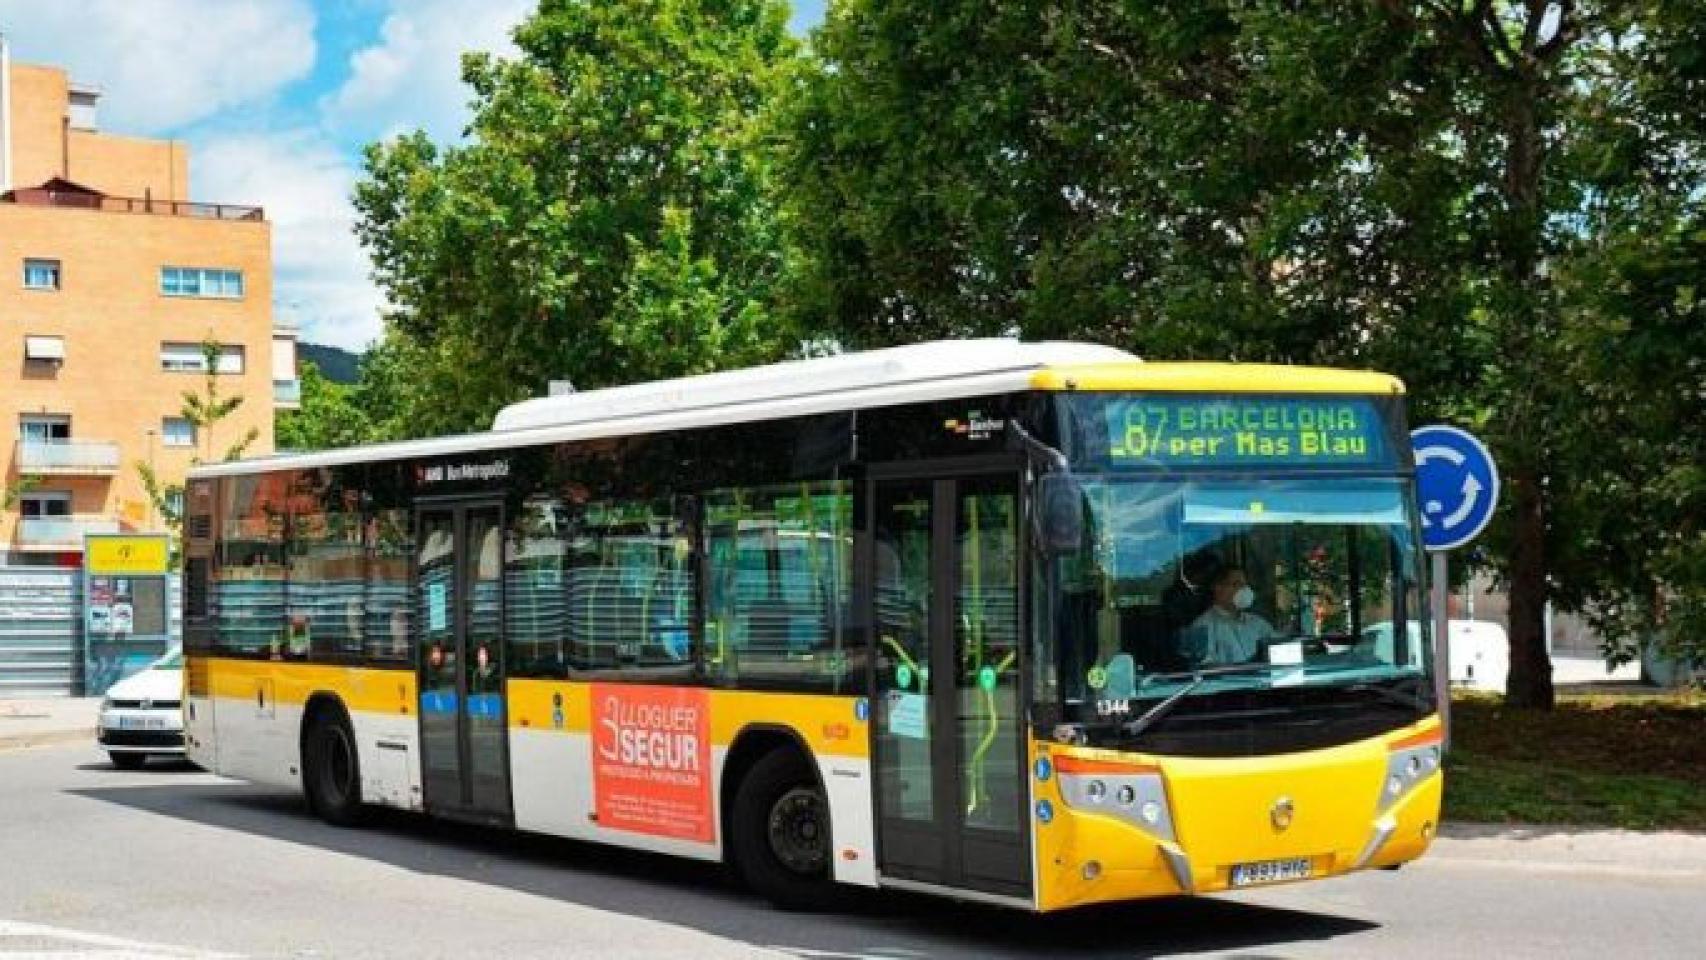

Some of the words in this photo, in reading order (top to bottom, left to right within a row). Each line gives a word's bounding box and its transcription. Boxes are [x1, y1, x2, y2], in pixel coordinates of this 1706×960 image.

[1178, 406, 1356, 430] BARCELONA
[1170, 436, 1224, 456] per
[1236, 431, 1290, 456] Mas
[1300, 431, 1367, 455] Blau
[619, 702, 698, 732] LLOGUER
[621, 728, 699, 771] SEGUR
